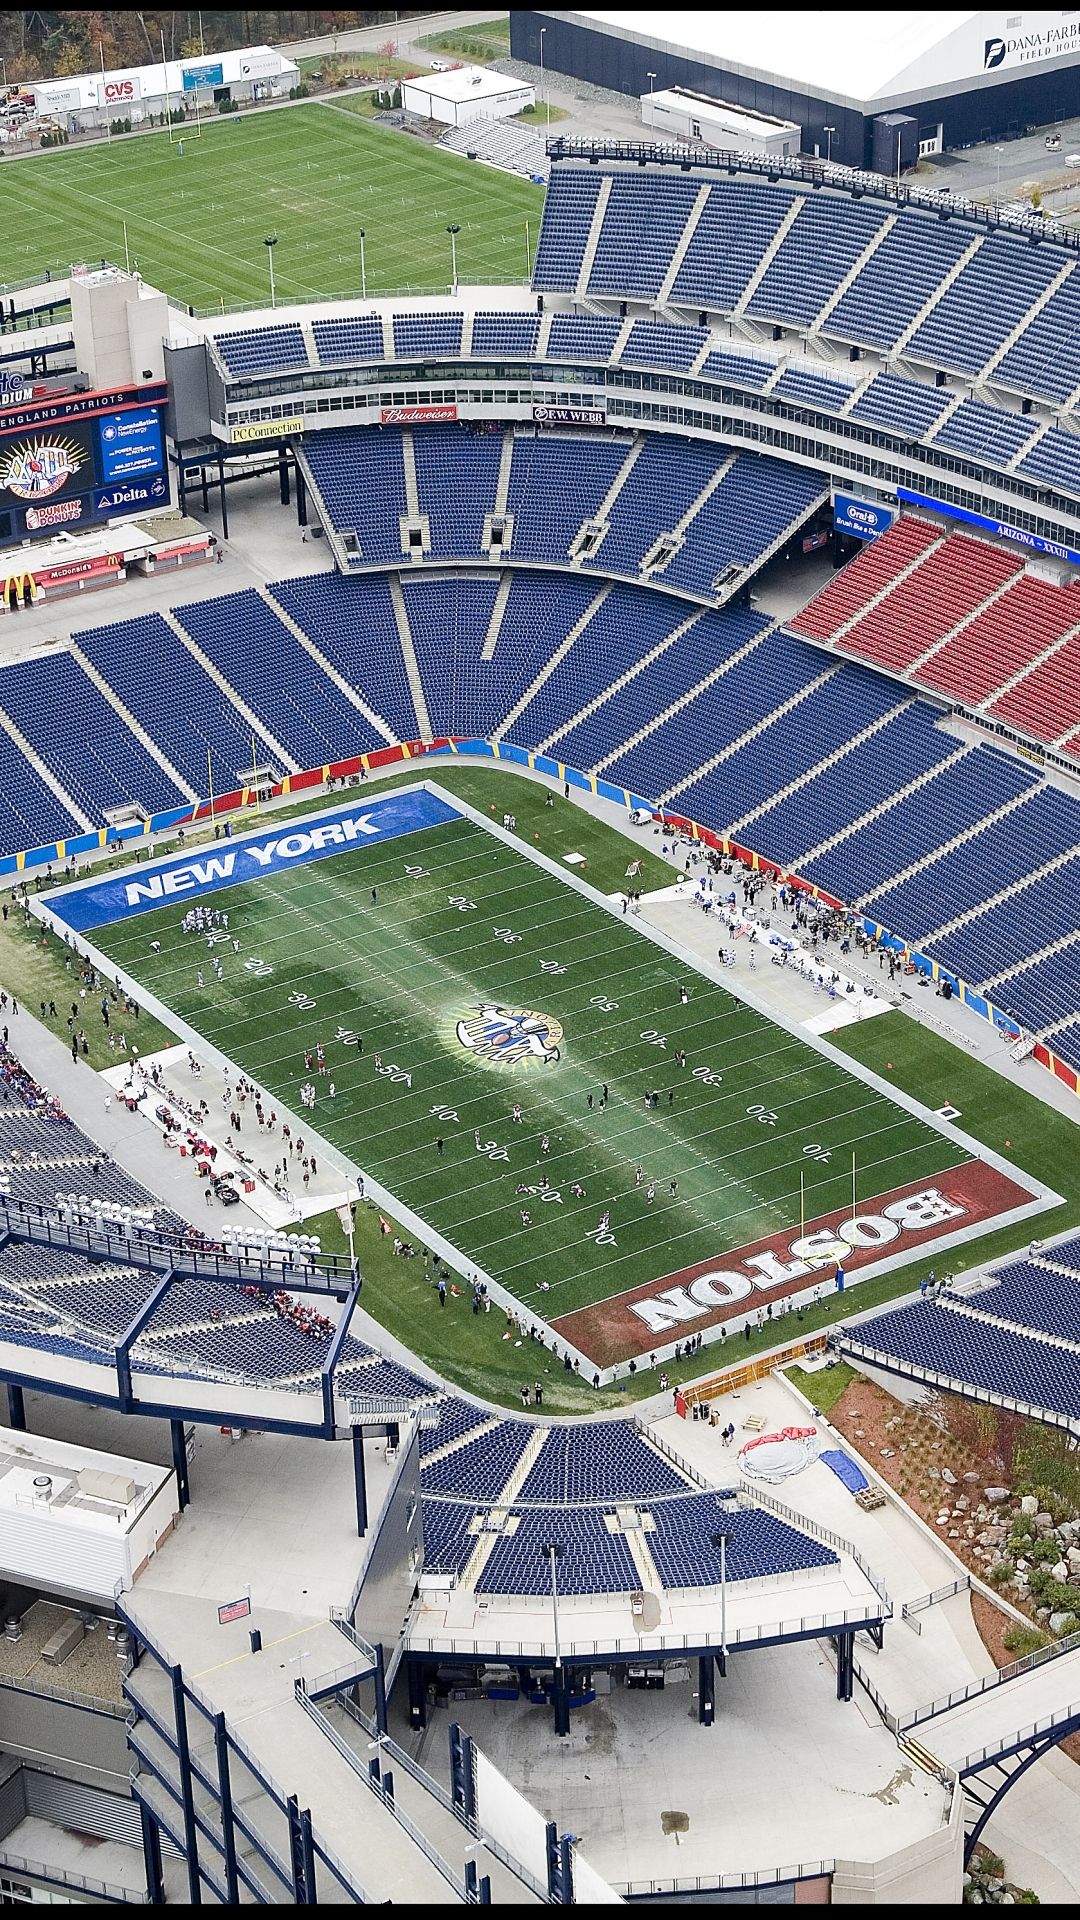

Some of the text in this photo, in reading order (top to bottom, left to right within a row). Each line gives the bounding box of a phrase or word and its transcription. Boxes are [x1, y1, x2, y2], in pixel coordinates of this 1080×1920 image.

[1007, 23, 1080, 53] DANA-FARB
[1020, 40, 1080, 61] FIELD HOU
[105, 81, 133, 97] CVS
[0, 387, 33, 406] DIUM
[0, 394, 124, 428] ENGLAND PATRIOTS
[383, 407, 454, 423] Budweiser
[548, 410, 603, 422] F.W. WEBB
[118, 419, 158, 432] Constellation
[233, 422, 301, 441] PC Connection
[112, 488, 148, 505] Delta
[39, 500, 81, 517] DUNKIN'
[849, 507, 875, 524] Oral-B
[40, 511, 79, 525] DONUTS
[836, 517, 853, 528] Brush
[997, 525, 1035, 547] ARIZONA
[50, 563, 92, 579] McDonald's
[125, 813, 381, 906] NEW YORK
[405, 865, 430, 880] 10
[449, 896, 477, 912] 20
[495, 927, 523, 944] 30
[244, 958, 273, 976] 20
[540, 960, 568, 976] 40
[288, 991, 317, 1010] 30
[590, 995, 619, 1013] 50
[334, 1027, 358, 1046] 40
[640, 1030, 668, 1047] 40
[379, 1064, 409, 1083] 50
[691, 1066, 723, 1086] 30
[429, 1104, 458, 1121] 40
[746, 1104, 779, 1124] 20
[477, 1141, 508, 1161] 30
[802, 1144, 833, 1162] 10
[528, 1184, 561, 1202] 20
[585, 1225, 616, 1244] 10
[627, 1186, 969, 1335] BOSTON
